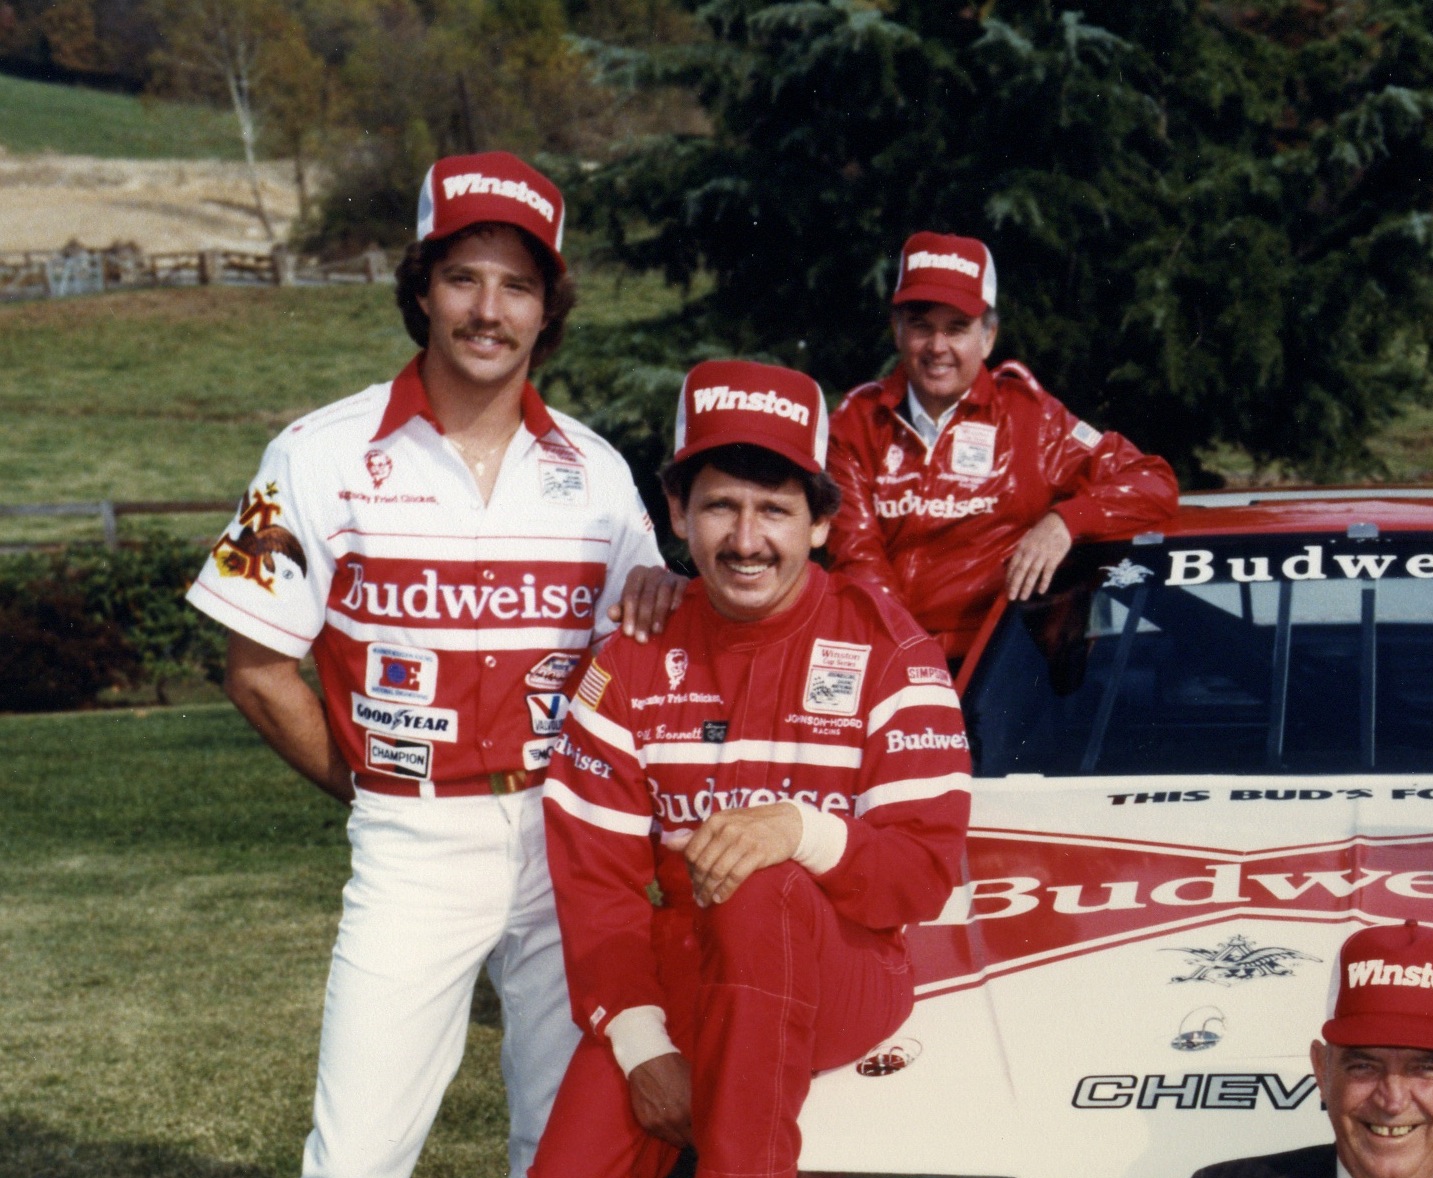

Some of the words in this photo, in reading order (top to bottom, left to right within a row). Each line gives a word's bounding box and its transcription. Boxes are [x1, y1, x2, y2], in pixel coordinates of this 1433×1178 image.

[443, 173, 554, 223] Winston
[908, 250, 980, 278] Winston
[693, 385, 810, 427] Winston
[821, 649, 861, 661] Winston
[655, 723, 702, 739] Bonnett
[812, 727, 841, 735] RACING
[372, 745, 425, 766] CHAMPION
[1107, 790, 1210, 805] THIS
[1229, 788, 1374, 801] BUD'S
